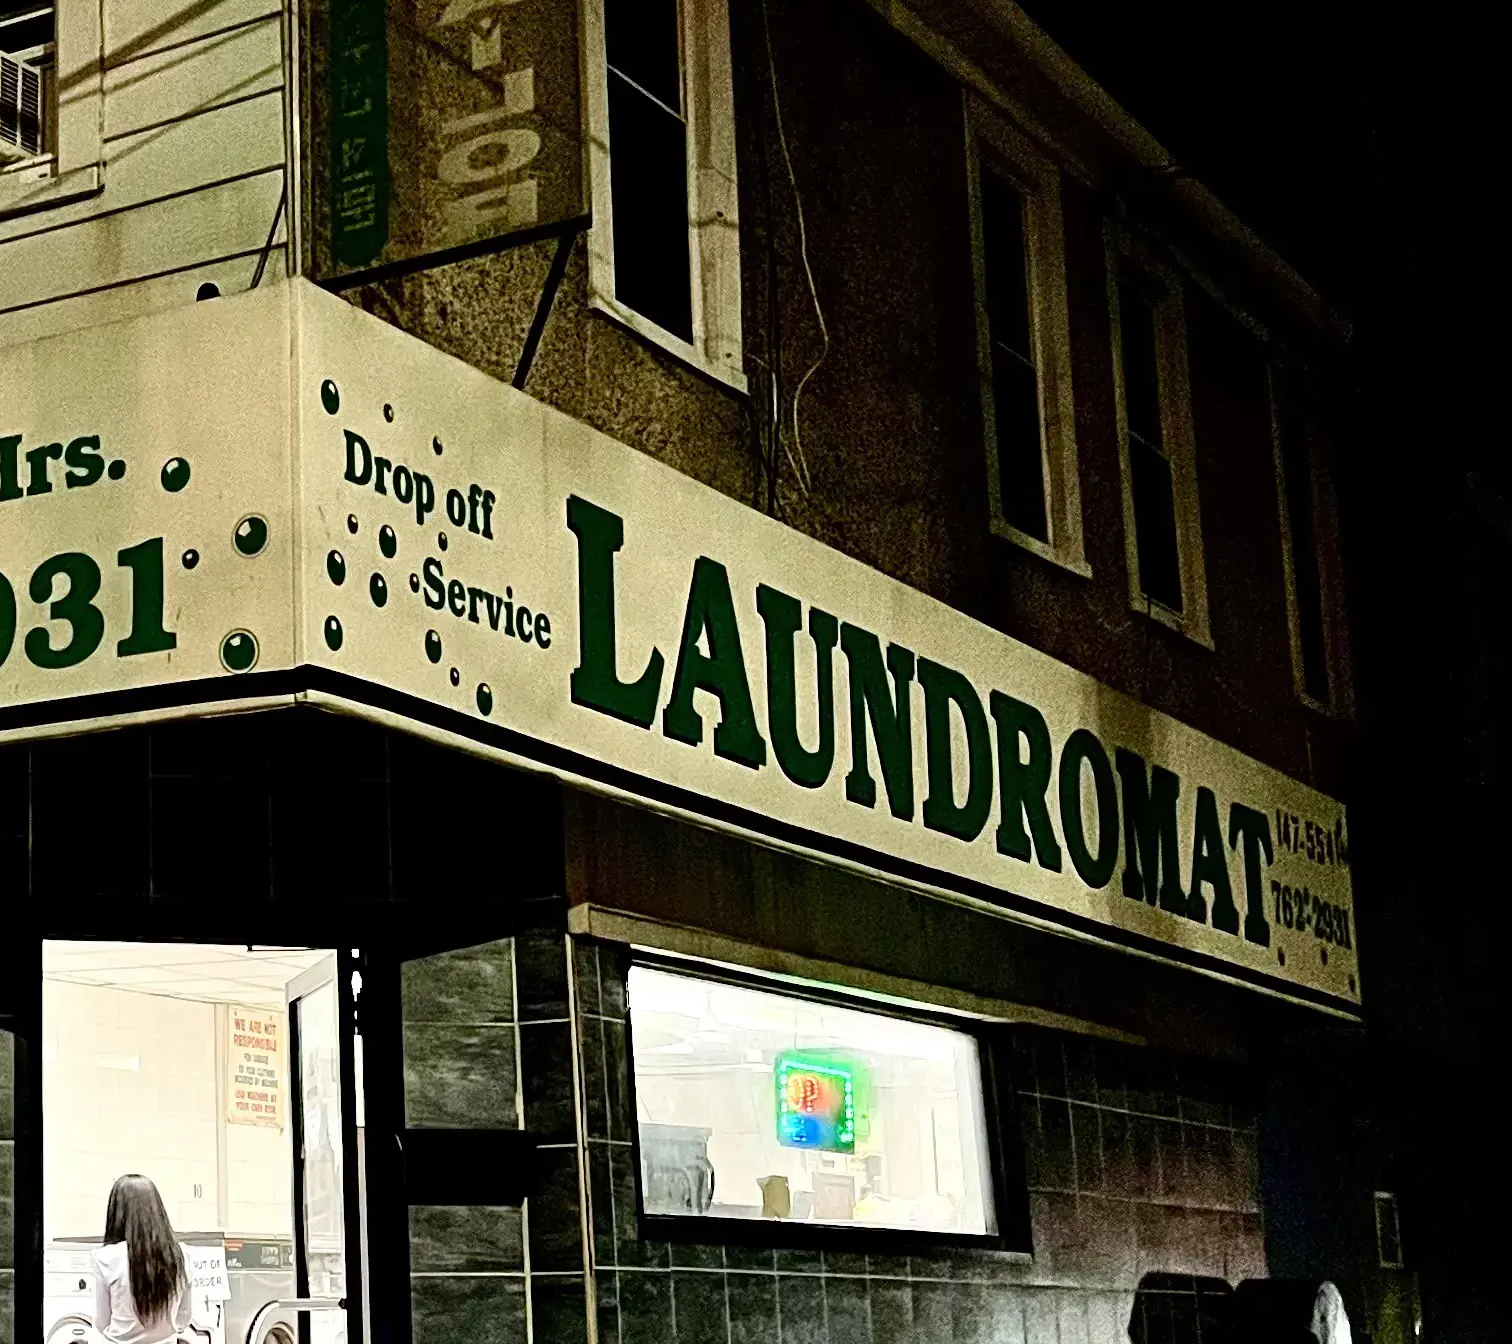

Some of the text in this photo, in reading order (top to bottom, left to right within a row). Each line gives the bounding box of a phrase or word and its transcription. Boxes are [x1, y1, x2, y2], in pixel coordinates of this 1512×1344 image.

[343, 429, 496, 540] Drop off
[422, 556, 552, 649] Service
[567, 494, 1274, 948] LAUNDROMAT
[1270, 879, 1352, 950] 762-2931
